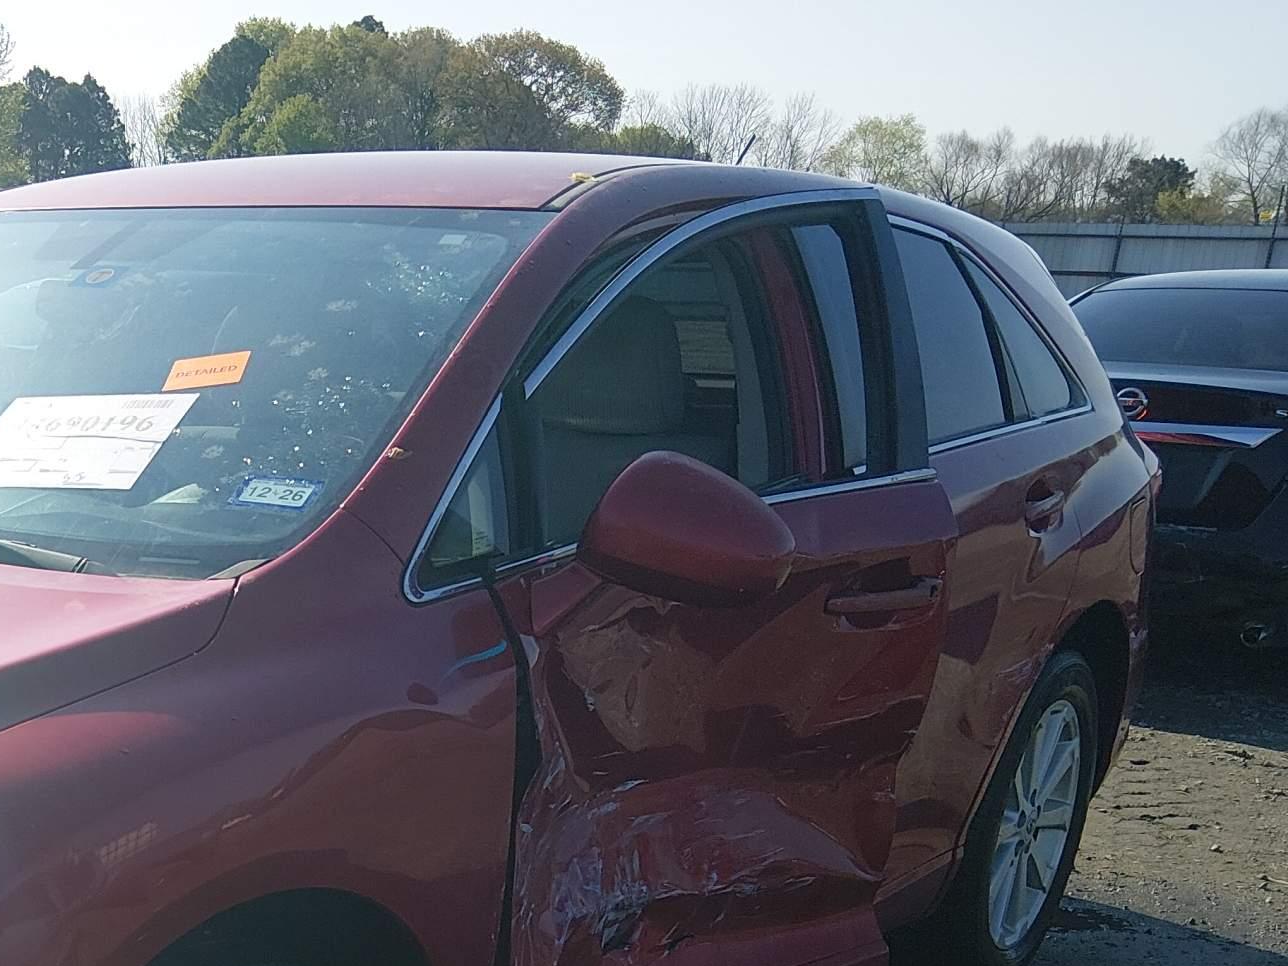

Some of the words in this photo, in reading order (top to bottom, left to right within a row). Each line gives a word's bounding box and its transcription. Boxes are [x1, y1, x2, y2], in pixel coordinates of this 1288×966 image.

[175, 364, 238, 379] DETAILED
[248, 486, 272, 498] 12
[278, 489, 306, 502] 26
